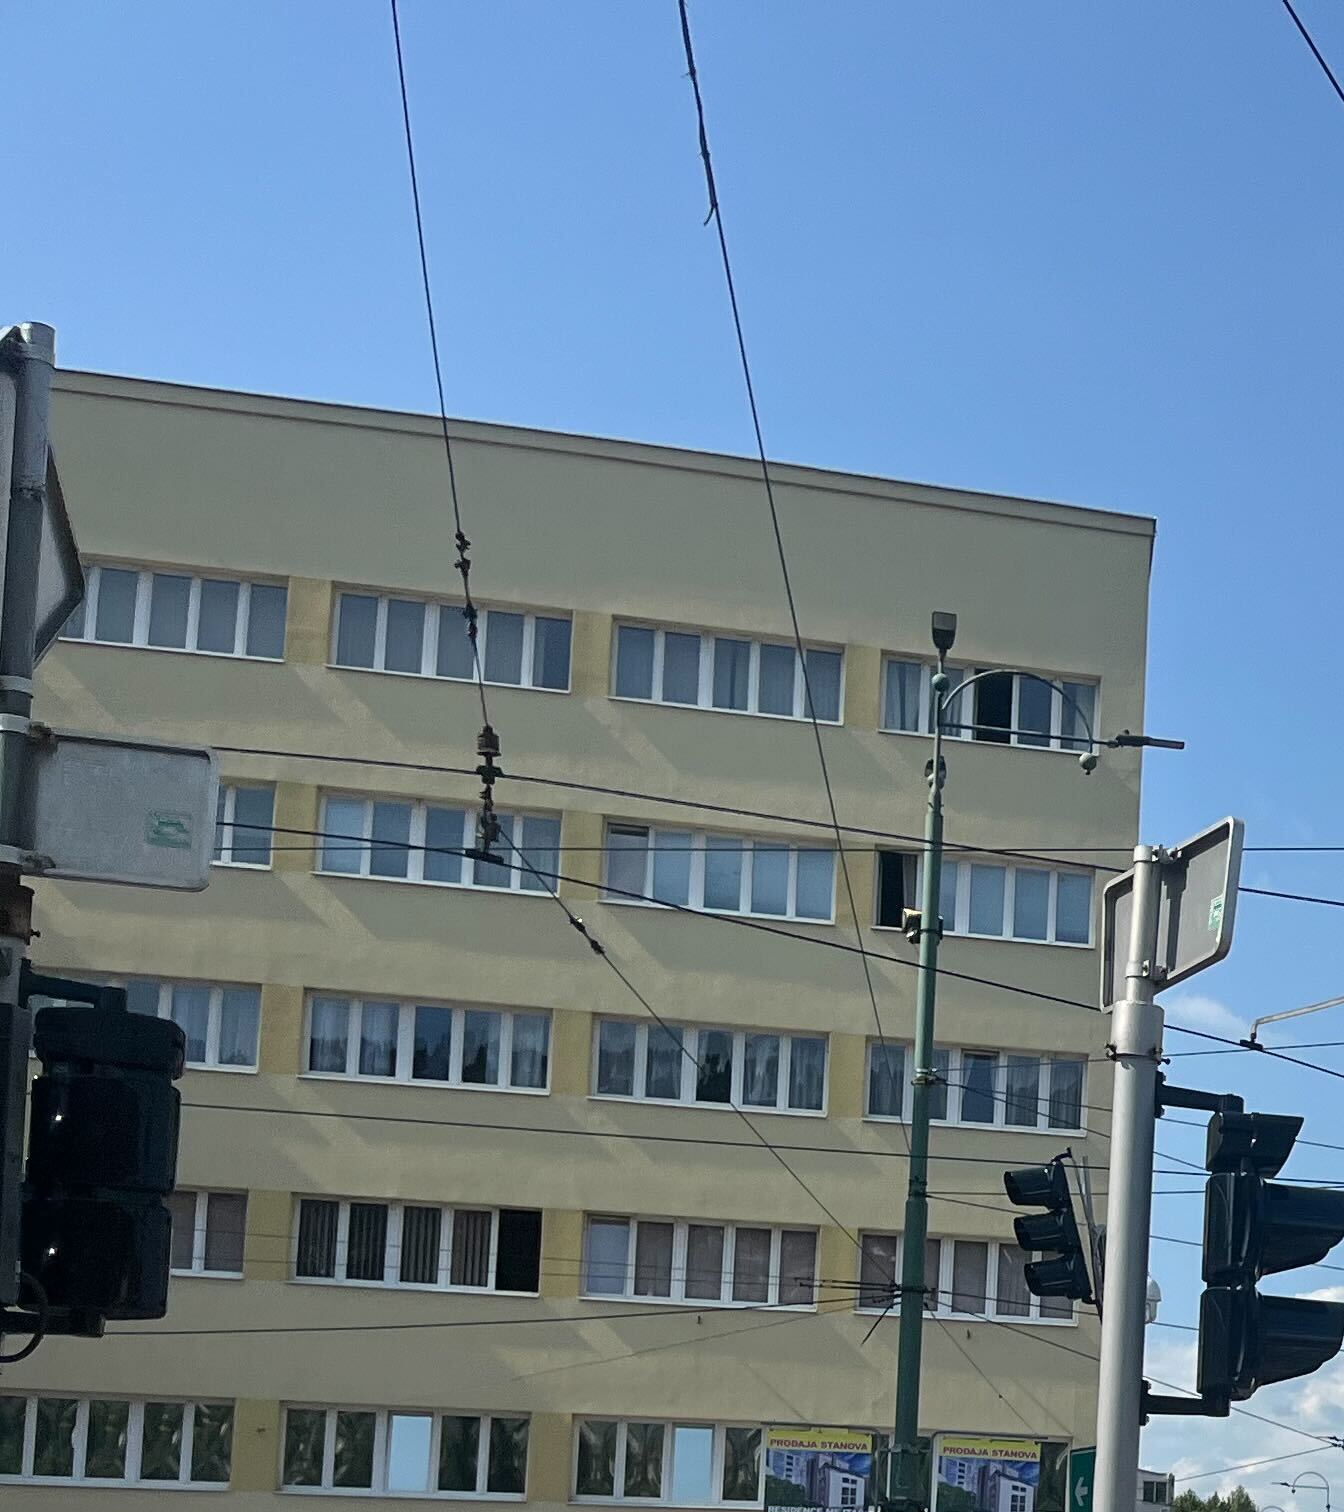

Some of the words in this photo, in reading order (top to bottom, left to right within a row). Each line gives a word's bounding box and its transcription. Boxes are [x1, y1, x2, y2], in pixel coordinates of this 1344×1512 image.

[770, 1438, 817, 1449] PRODAJA
[821, 1441, 868, 1451] STANOVA
[943, 1446, 989, 1457] PRODAJA
[992, 1449, 1037, 1459] STANOVA
